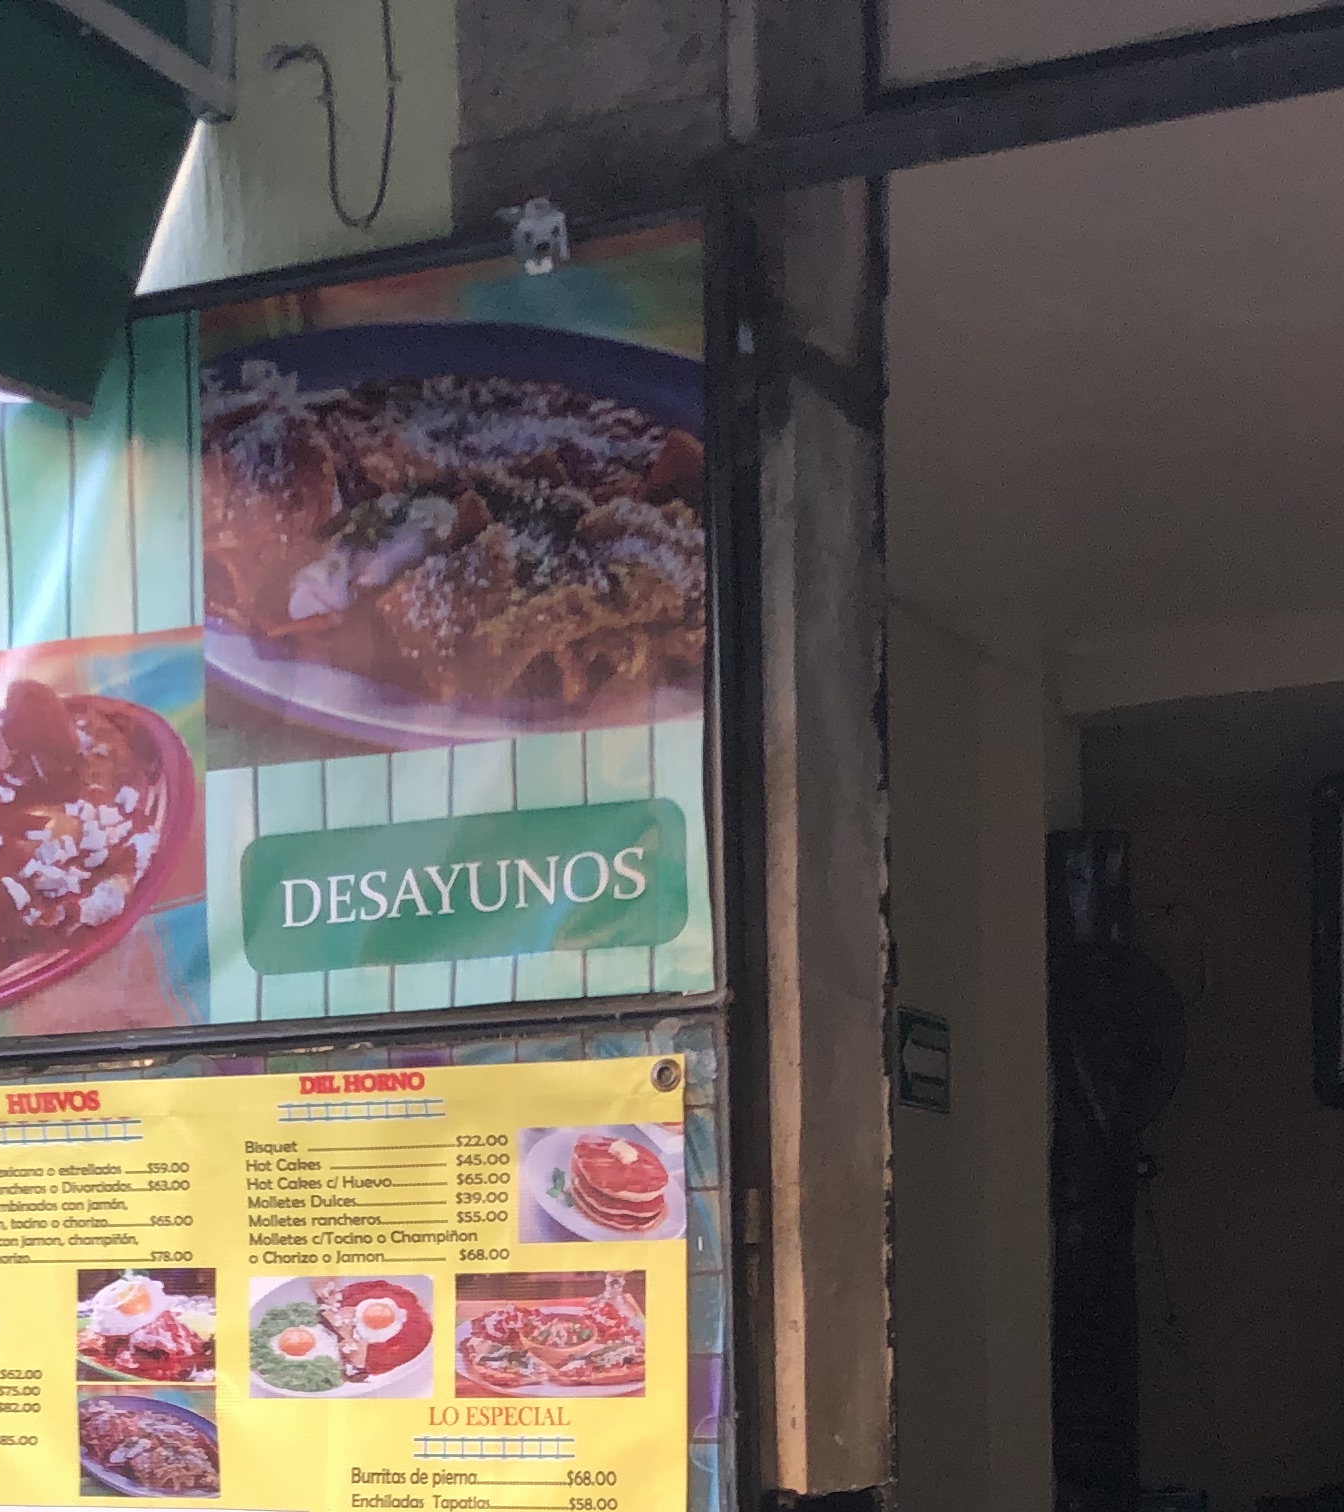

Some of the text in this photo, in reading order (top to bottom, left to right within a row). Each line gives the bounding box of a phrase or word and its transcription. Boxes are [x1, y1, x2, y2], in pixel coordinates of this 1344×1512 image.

[281, 847, 647, 929] DESAYUNOS
[299, 1071, 425, 1094] DEL HORNO
[6, 1090, 100, 1114] HUEVOS
[245, 1134, 508, 1154] Bisquet $22.00
[47, 1168, 55, 1177] o
[58, 1163, 121, 1176] estrellados
[147, 1162, 189, 1175] $59.00
[246, 1154, 510, 1172] Hot Cakes $45.00
[50, 1185, 58, 1194] o
[62, 1180, 131, 1194] Divorciados
[247, 1172, 510, 1191] Hot Cakes c/ Huevo $65.00
[61, 1201, 84, 1210] con
[248, 1191, 508, 1209] Molletes Dulces $39.00
[51, 1219, 60, 1228] o
[151, 1215, 193, 1228] $65.00
[248, 1210, 508, 1227] Molletes rancheros $55.00
[249, 1229, 477, 1246] Molletes c/Tocino o Champiñon
[151, 1251, 193, 1263] $78.00
[248, 1247, 510, 1265] o Chorizo o Jamon $68.00
[429, 1406, 571, 1427] LO ESPECIAL
[351, 1467, 617, 1488] Burritas de pierna $68.00
[351, 1493, 424, 1509] Enchiladas
[569, 1498, 618, 1511] $58.00
